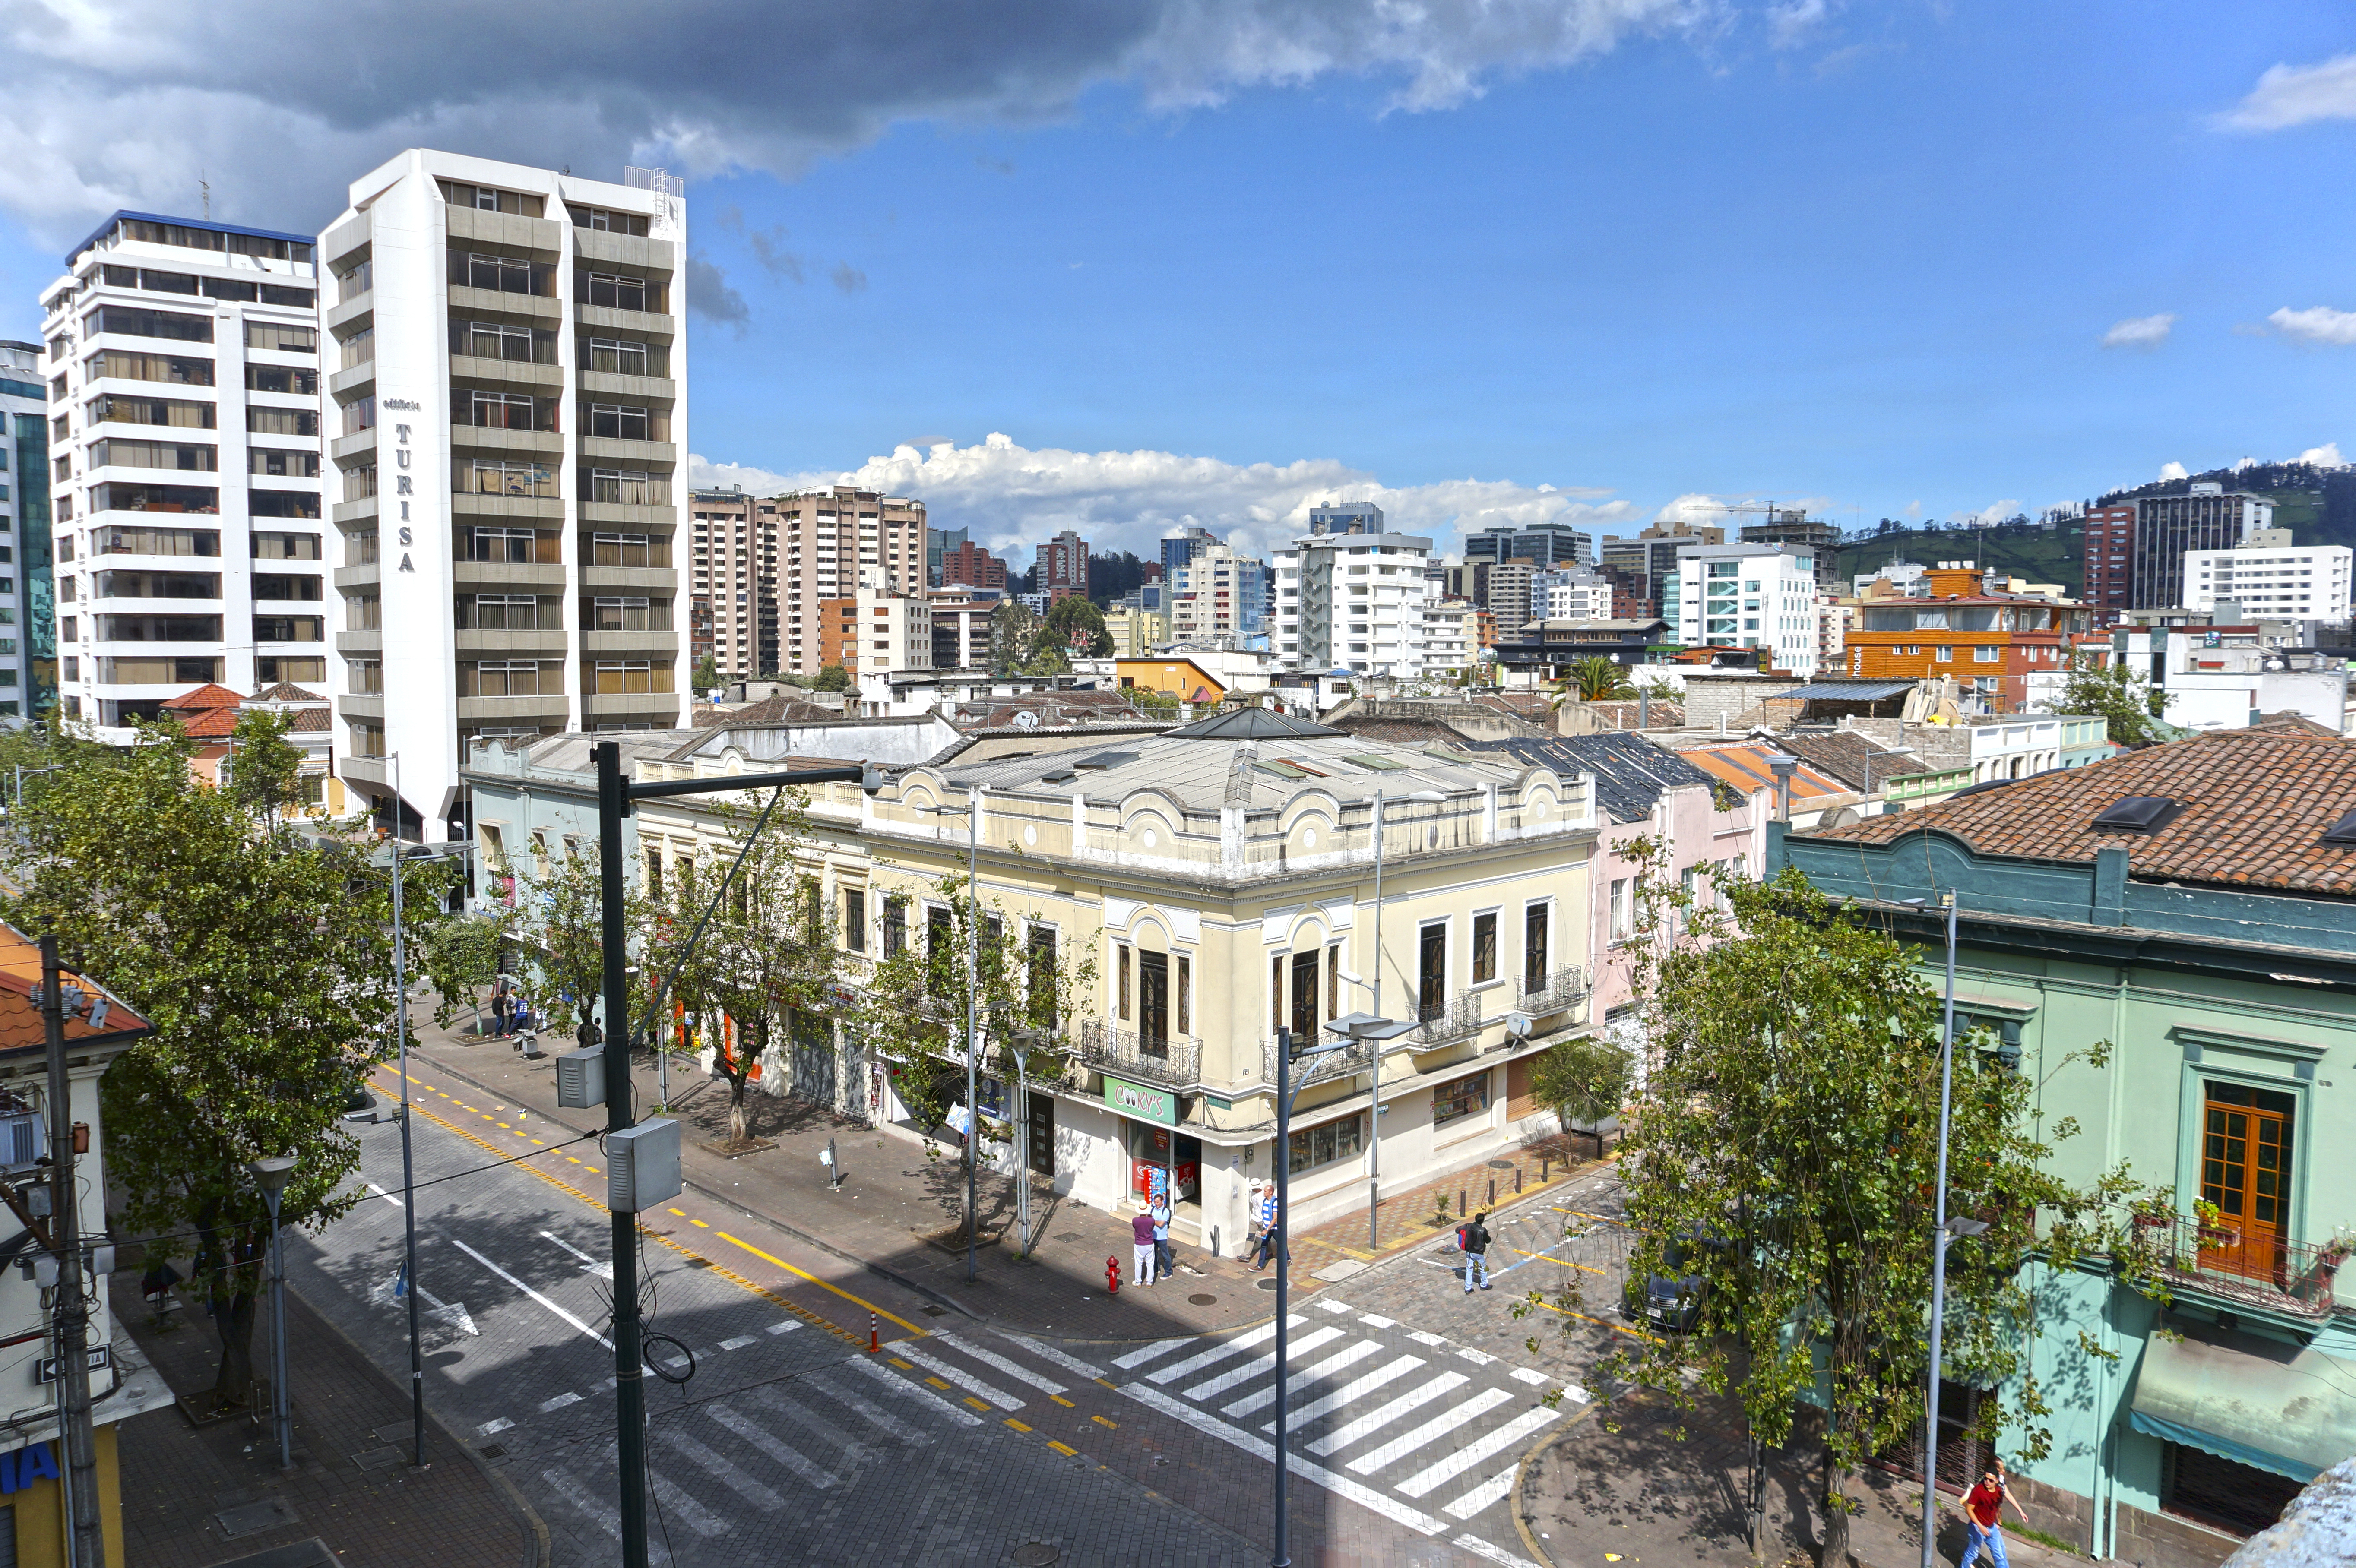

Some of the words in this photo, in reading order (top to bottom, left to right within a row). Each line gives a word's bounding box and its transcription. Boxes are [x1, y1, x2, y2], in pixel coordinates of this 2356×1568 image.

[383, 398, 421, 410] edificio
[396, 424, 414, 570] TURISA
[1851, 646, 1862, 679] house
[1115, 1085, 1164, 1117] COOKY'S
